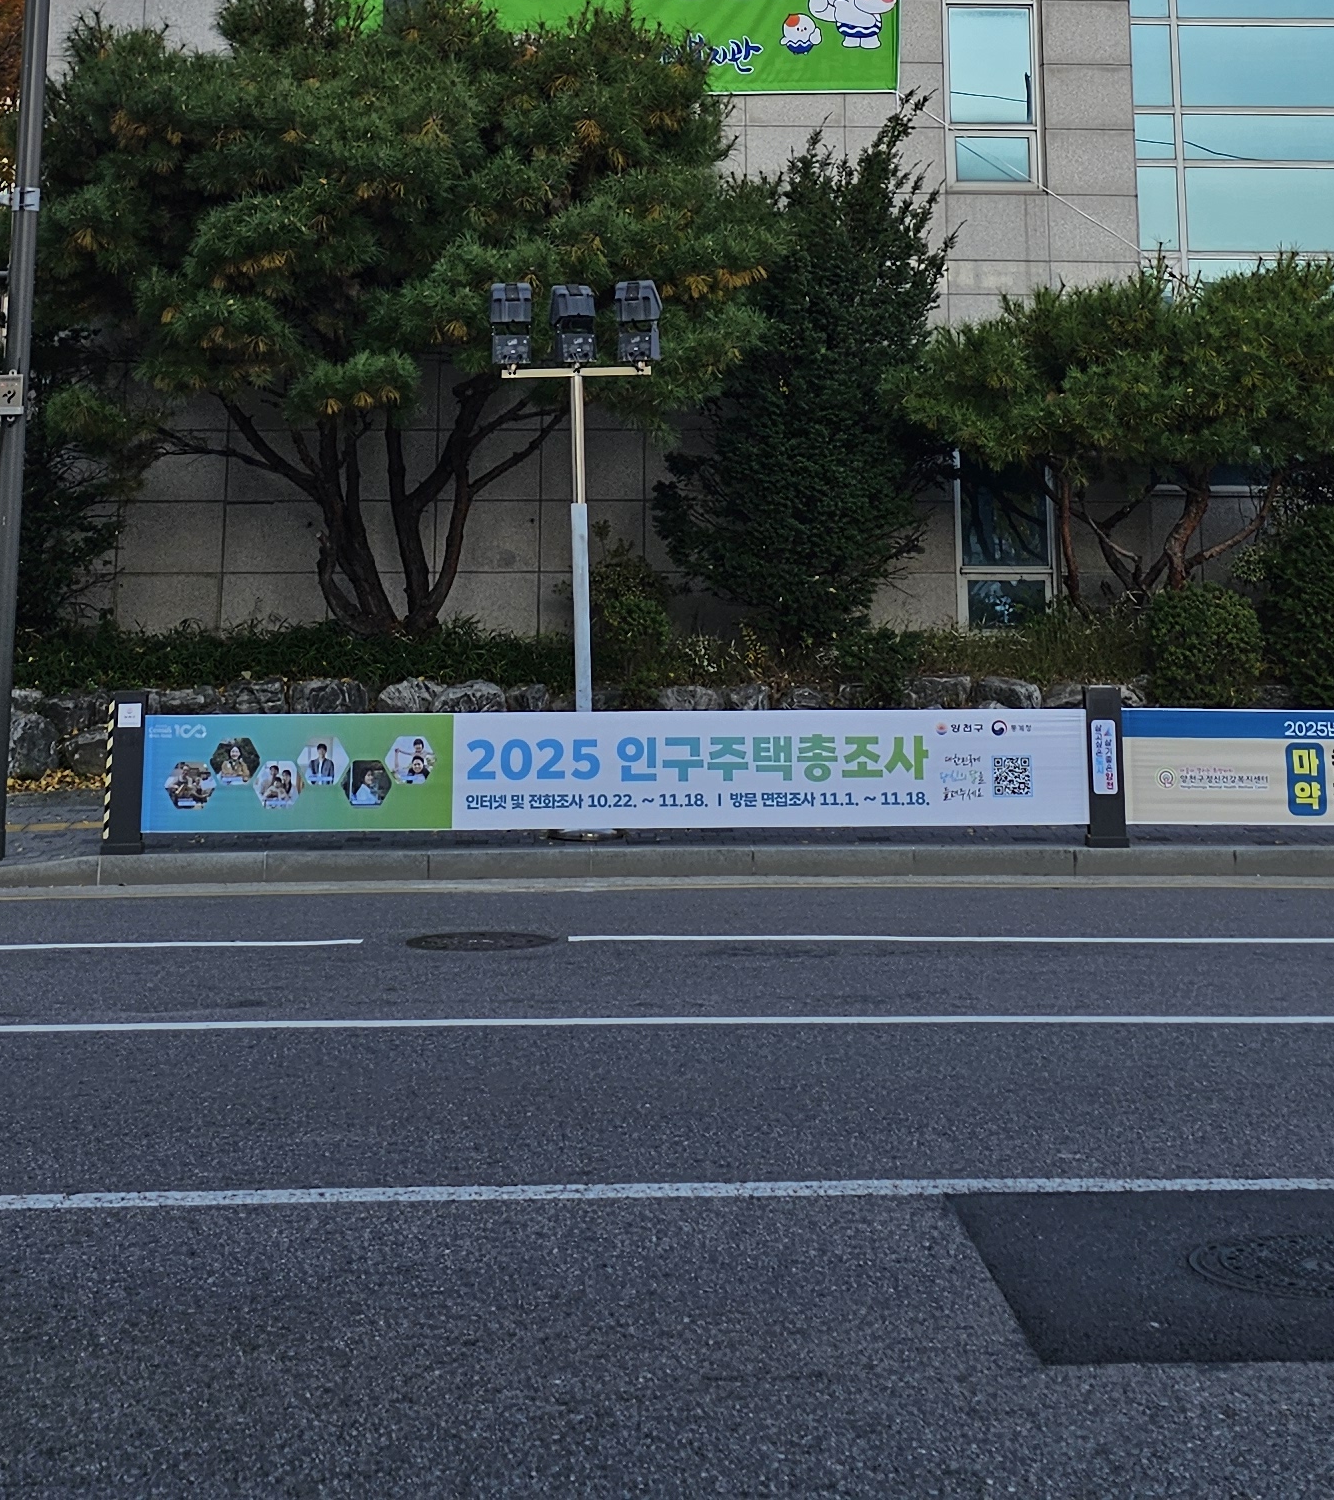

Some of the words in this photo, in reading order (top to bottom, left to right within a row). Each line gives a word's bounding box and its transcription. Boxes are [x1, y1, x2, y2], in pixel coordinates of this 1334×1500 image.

[951, 723, 983, 733] 양천구
[467, 738, 600, 781] 2025
[616, 733, 929, 783] 인구주택총조사
[465, 793, 507, 810] 인터넷
[511, 793, 525, 810] 및
[528, 793, 584, 810] 전화조사
[587, 793, 637, 808] 10.22.
[659, 793, 708, 808] 11.18.
[729, 792, 757, 808] 방문
[761, 792, 815, 808] 면접조사
[820, 792, 859, 807] 11.1.
[880, 791, 930, 807] 11.18.
